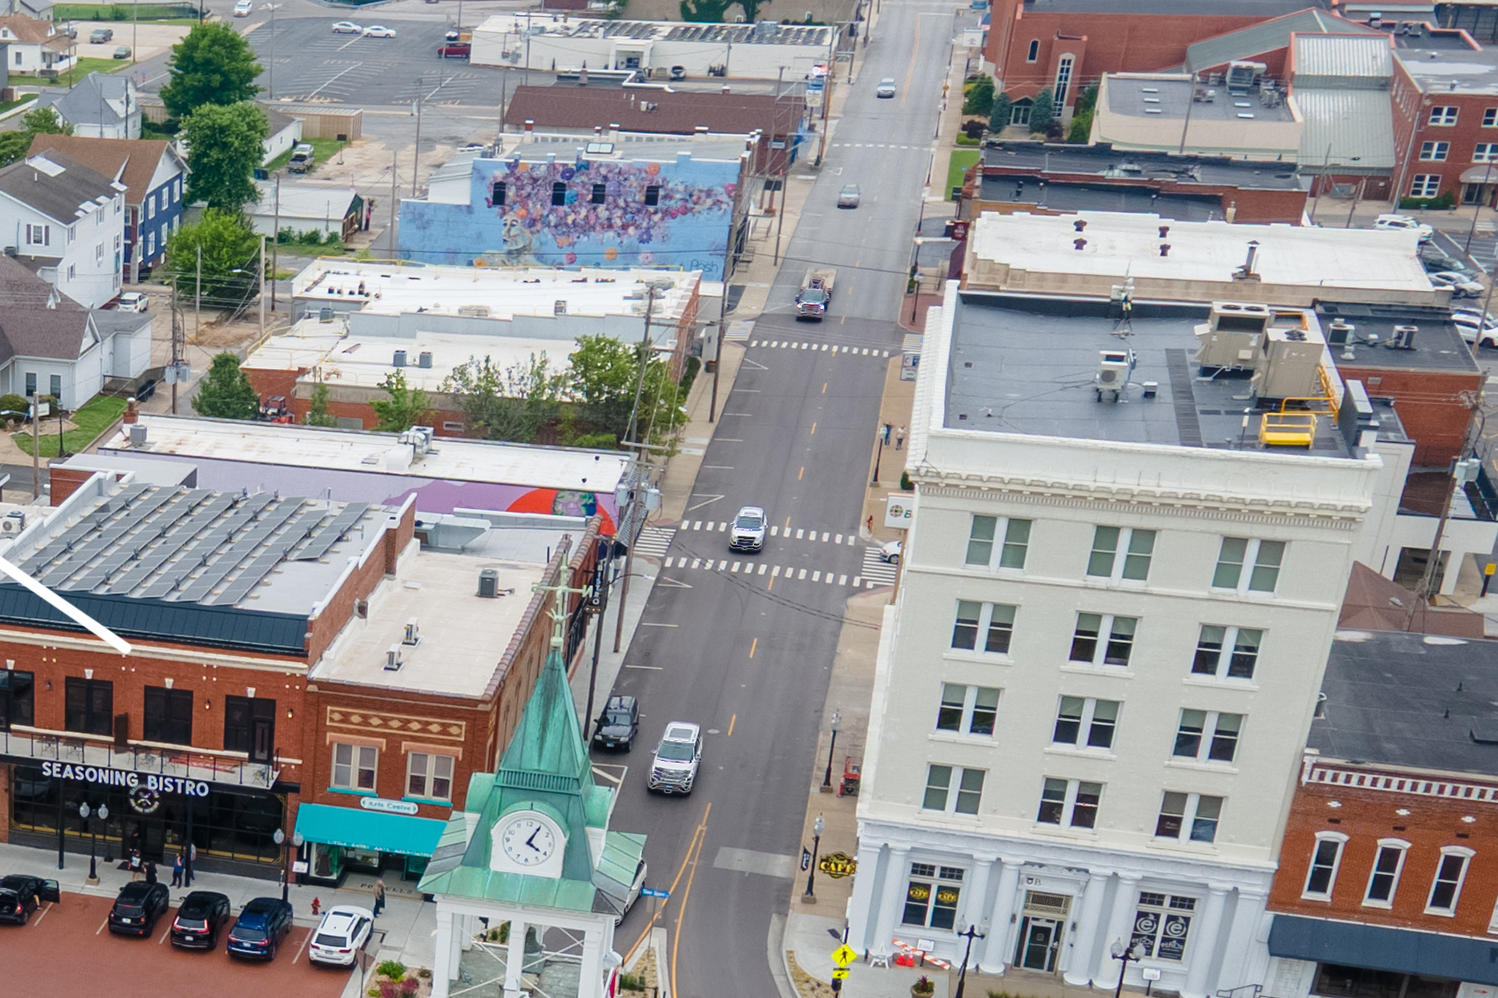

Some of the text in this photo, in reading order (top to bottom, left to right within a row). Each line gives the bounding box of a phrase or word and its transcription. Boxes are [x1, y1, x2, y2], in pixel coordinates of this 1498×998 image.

[41, 761, 210, 798] SEASONING BISTRO
[360, 883, 413, 895] POELLS
